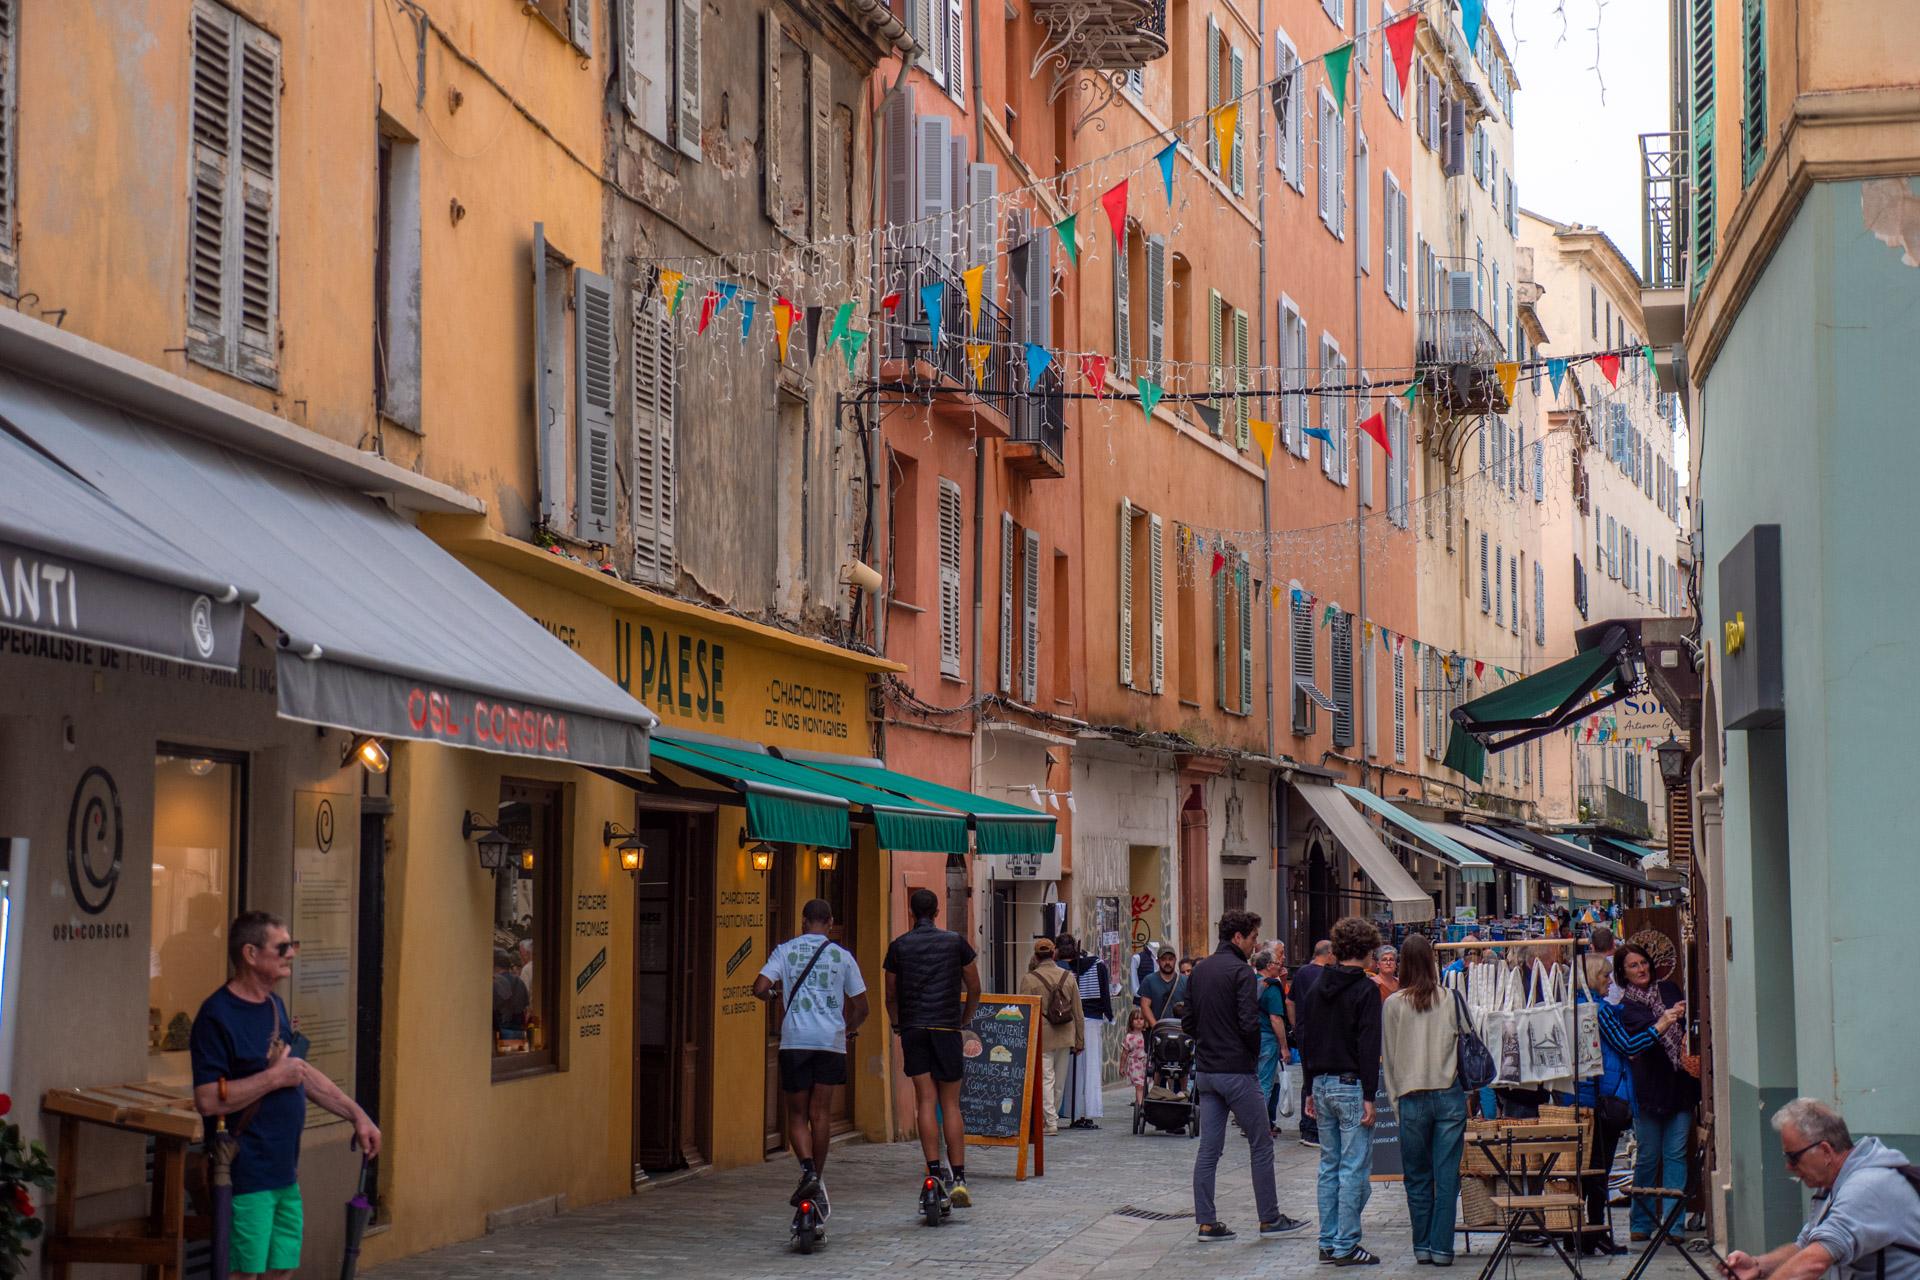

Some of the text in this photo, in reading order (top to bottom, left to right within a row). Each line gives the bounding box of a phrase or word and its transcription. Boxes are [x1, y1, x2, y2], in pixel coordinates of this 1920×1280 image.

[616, 619, 724, 722] U PAESE
[771, 680, 841, 715] CHARCUTERIE
[408, 688, 568, 752] OSL CORSICA
[765, 710, 848, 738] DE NOS MONTAGNES
[1624, 720, 1659, 731] Artisan
[81, 923, 129, 939] CORSICA
[575, 921, 608, 937] FROMAGE
